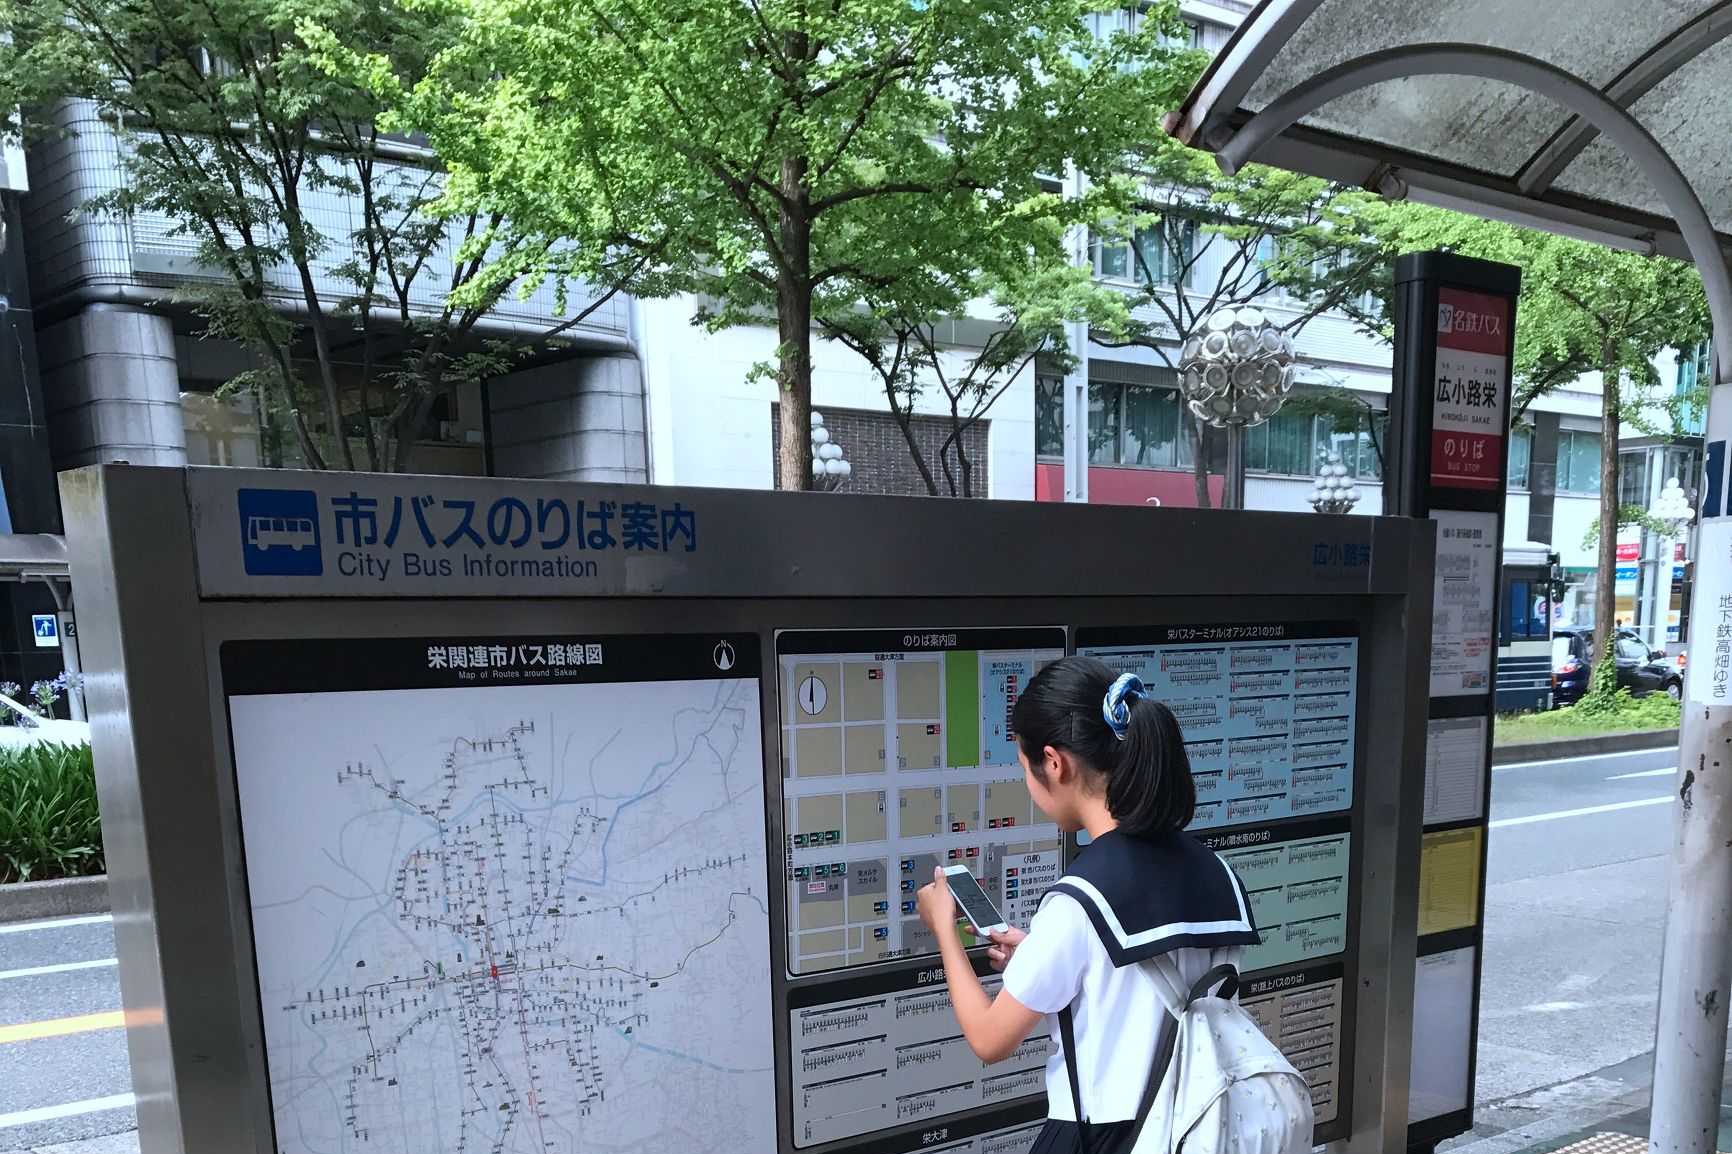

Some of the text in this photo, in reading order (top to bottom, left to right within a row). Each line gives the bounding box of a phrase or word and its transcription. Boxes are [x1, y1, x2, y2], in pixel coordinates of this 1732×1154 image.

[1455, 310, 1500, 335] 名鉄バス
[1437, 376, 1497, 409] 広小路栄
[1472, 415, 1490, 425] SAKAE
[1444, 438, 1484, 460] のりば
[1448, 462, 1480, 472] BUS STOP
[332, 492, 696, 553] 市バスのりば案内
[337, 553, 598, 581] City Bus Information
[68, 624, 75, 636] 2
[903, 634, 956, 647] のりば案内図
[427, 643, 603, 670] 栄関連市バス路線図
[1713, 593, 1732, 698] 地下鉄高畑ゆき
[458, 667, 577, 681] Map of Routes around Sakae
[922, 1128, 948, 1145] 栄大津
